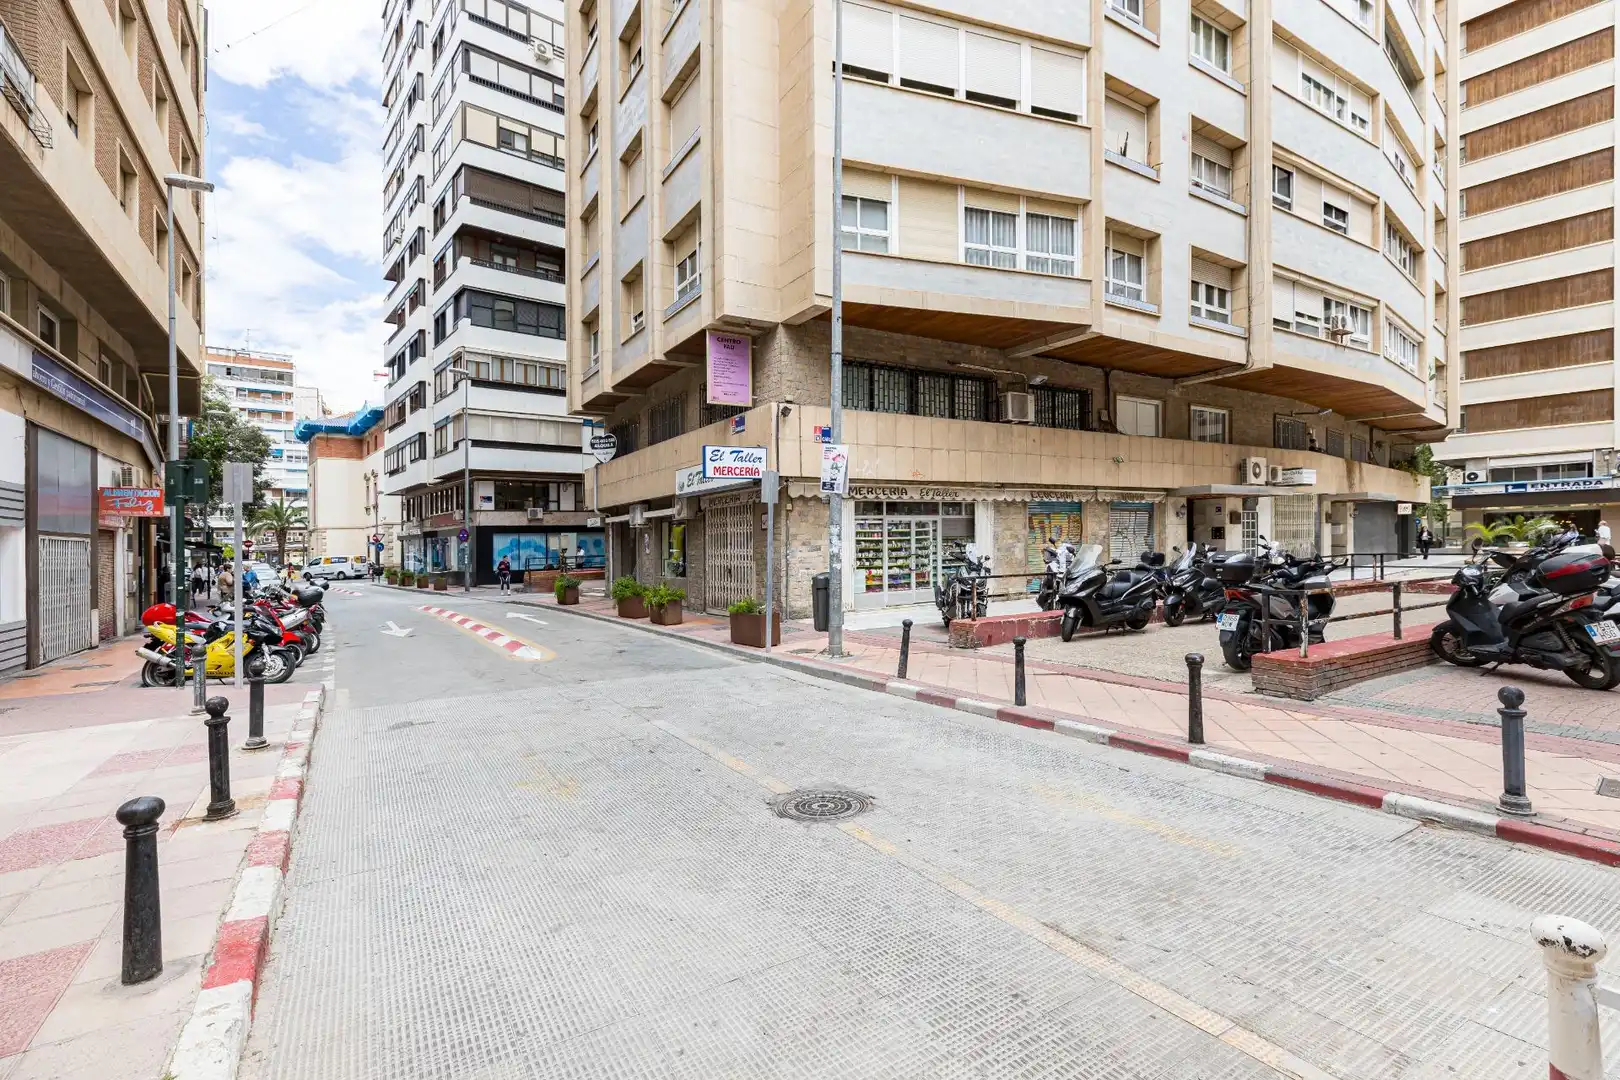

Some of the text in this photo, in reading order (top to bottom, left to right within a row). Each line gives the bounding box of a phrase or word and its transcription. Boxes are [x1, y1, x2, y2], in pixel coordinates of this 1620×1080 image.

[716, 337, 742, 345] CENTRO
[709, 449, 764, 463] El Taller
[1530, 480, 1604, 489] ENTRADA
[920, 488, 930, 497] El
[931, 488, 959, 498] Taller
[1600, 630, 1617, 640] HSG
